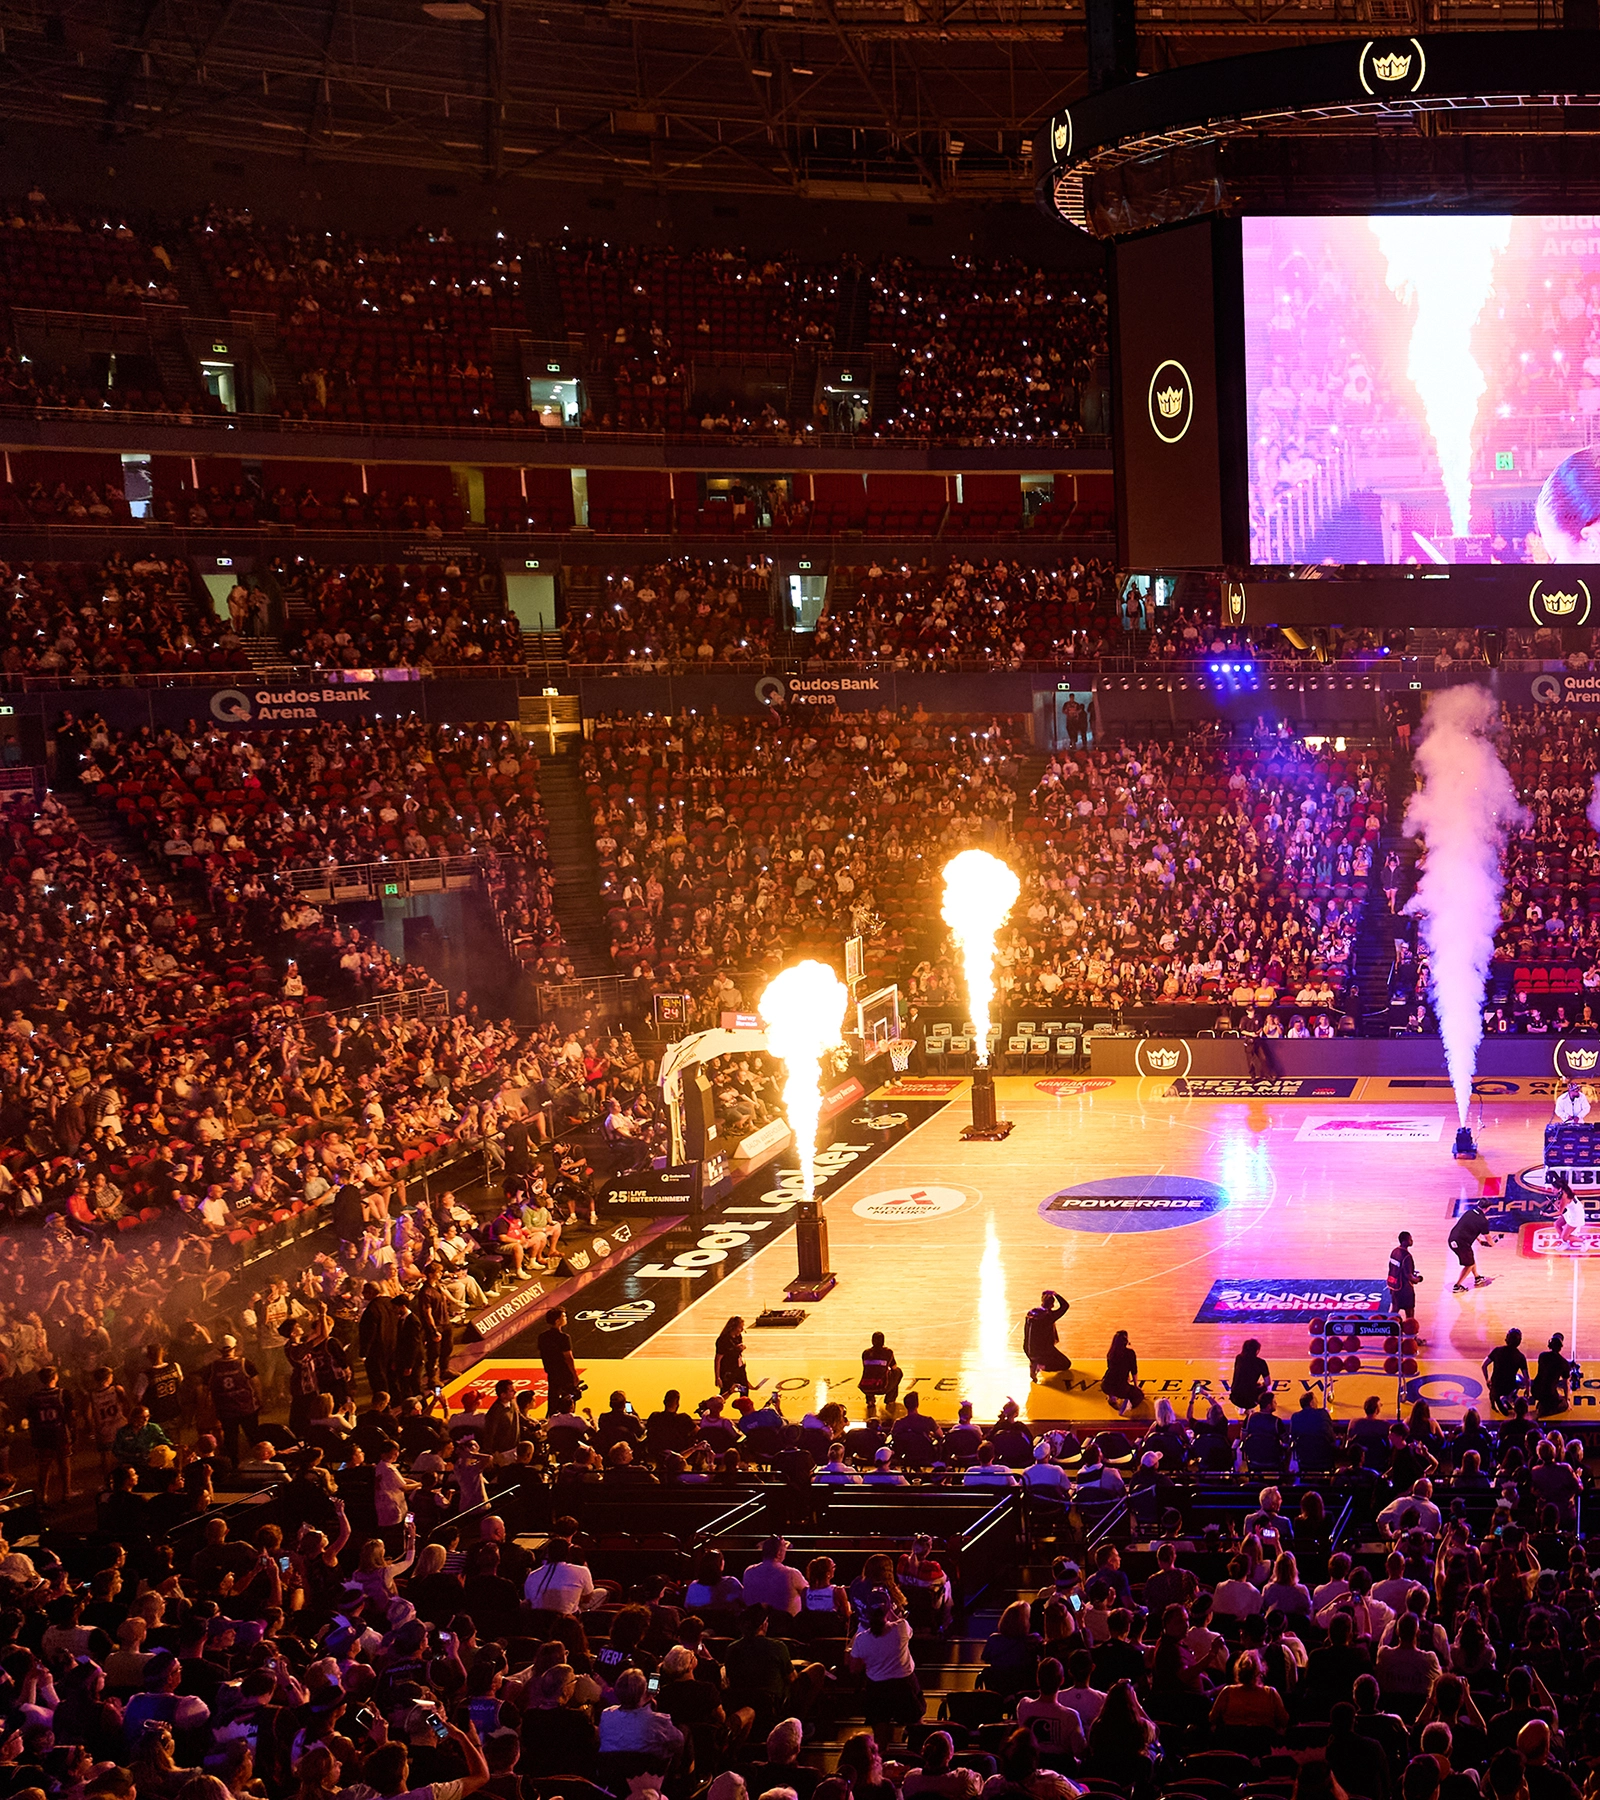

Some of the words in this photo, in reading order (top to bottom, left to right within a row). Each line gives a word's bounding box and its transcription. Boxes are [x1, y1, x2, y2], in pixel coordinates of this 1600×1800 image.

[789, 678, 840, 691] Qudos
[841, 677, 880, 690] Bank
[255, 690, 323, 705] Qudos
[322, 688, 371, 702] Bank
[257, 706, 318, 720] Arena
[663, 1008, 679, 1019] 24
[608, 1190, 628, 1203] 25
[1061, 1199, 1205, 1208] POWERADE
[634, 1220, 773, 1278] Foot
[1218, 1291, 1382, 1302] BUNNINGS
[475, 1313, 501, 1335] BUILT
[499, 1303, 515, 1322] FOR
[513, 1281, 545, 1311] SYDNEY
[1359, 1326, 1391, 1335] SPALDING
